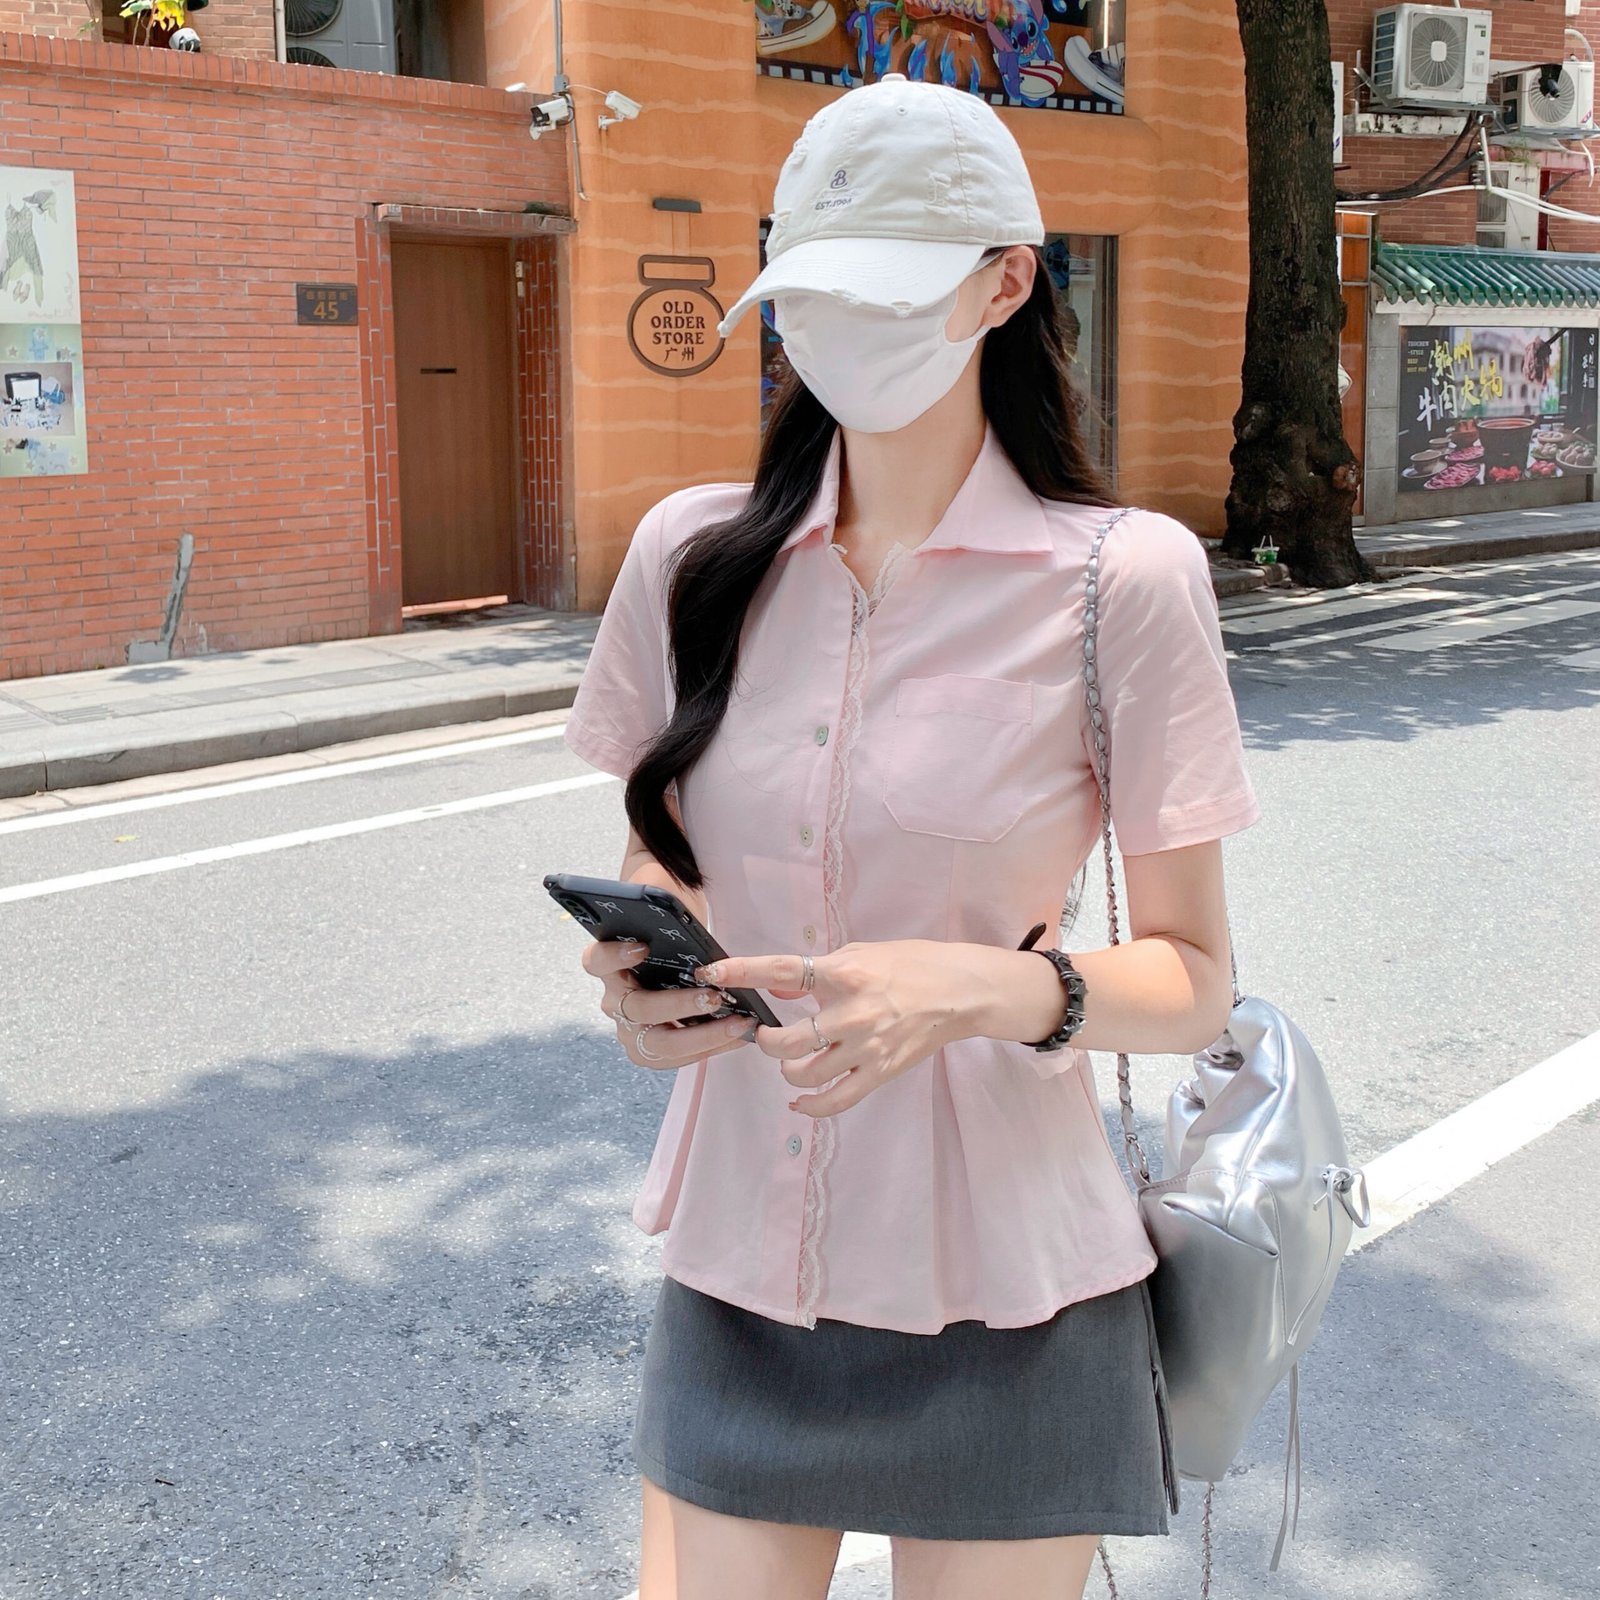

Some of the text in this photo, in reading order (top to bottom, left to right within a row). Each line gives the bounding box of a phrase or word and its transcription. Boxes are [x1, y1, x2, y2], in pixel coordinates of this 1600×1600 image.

[313, 301, 339, 320] 45
[662, 301, 694, 314] OLD
[651, 316, 706, 329] ORDER
[652, 332, 705, 345] STORE
[663, 347, 695, 362] 广州
[1417, 358, 1504, 432] 牛肉火锅
